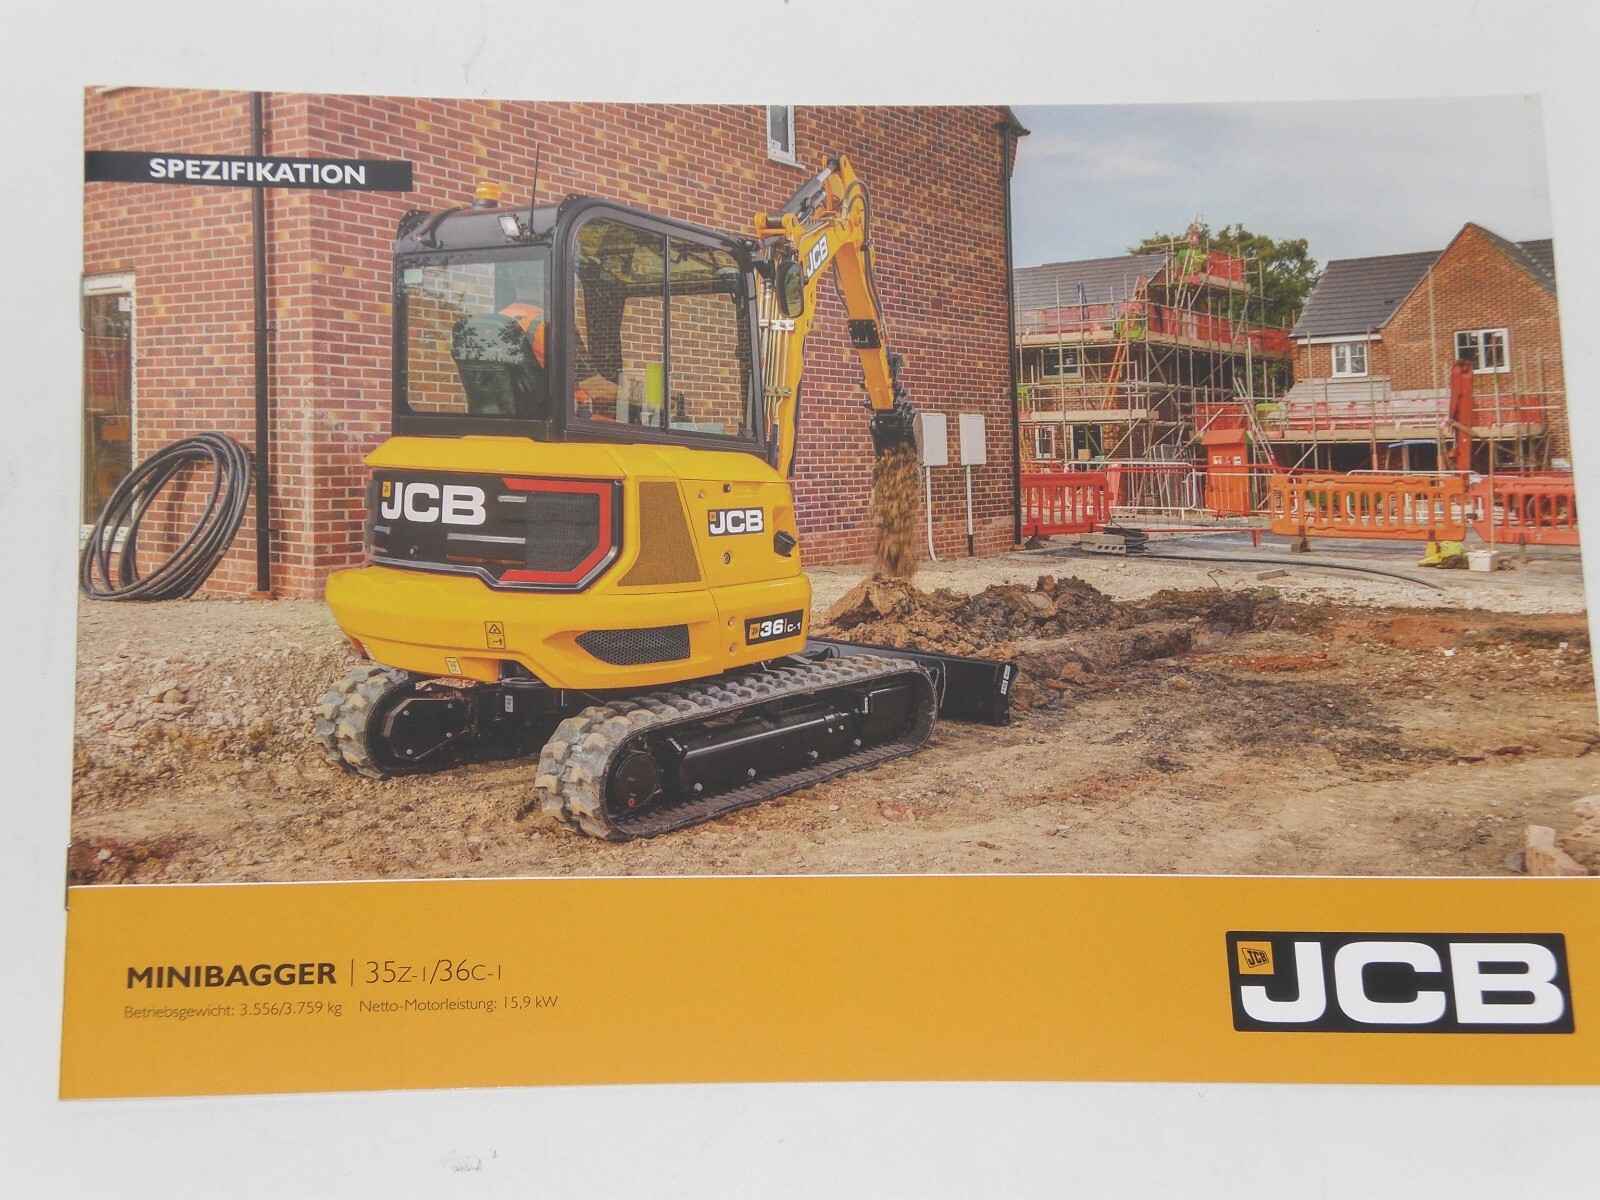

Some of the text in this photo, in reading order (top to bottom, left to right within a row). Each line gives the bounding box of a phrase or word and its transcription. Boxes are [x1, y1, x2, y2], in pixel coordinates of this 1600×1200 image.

[149, 158, 366, 185] SPEZIFIKATION
[806, 235, 828, 278] JCB
[381, 481, 486, 526] JCB
[709, 509, 764, 535] JCB
[760, 619, 784, 637] 36
[1246, 949, 1268, 966] JCB
[126, 962, 337, 989] MINIBAGGER
[1240, 941, 1566, 1024] JCB
[124, 1001, 342, 1021] Betriebsgewicht: 3.556/3.759 kg
[359, 995, 558, 1013] Netto-Motorleistung: 15,9 kW
